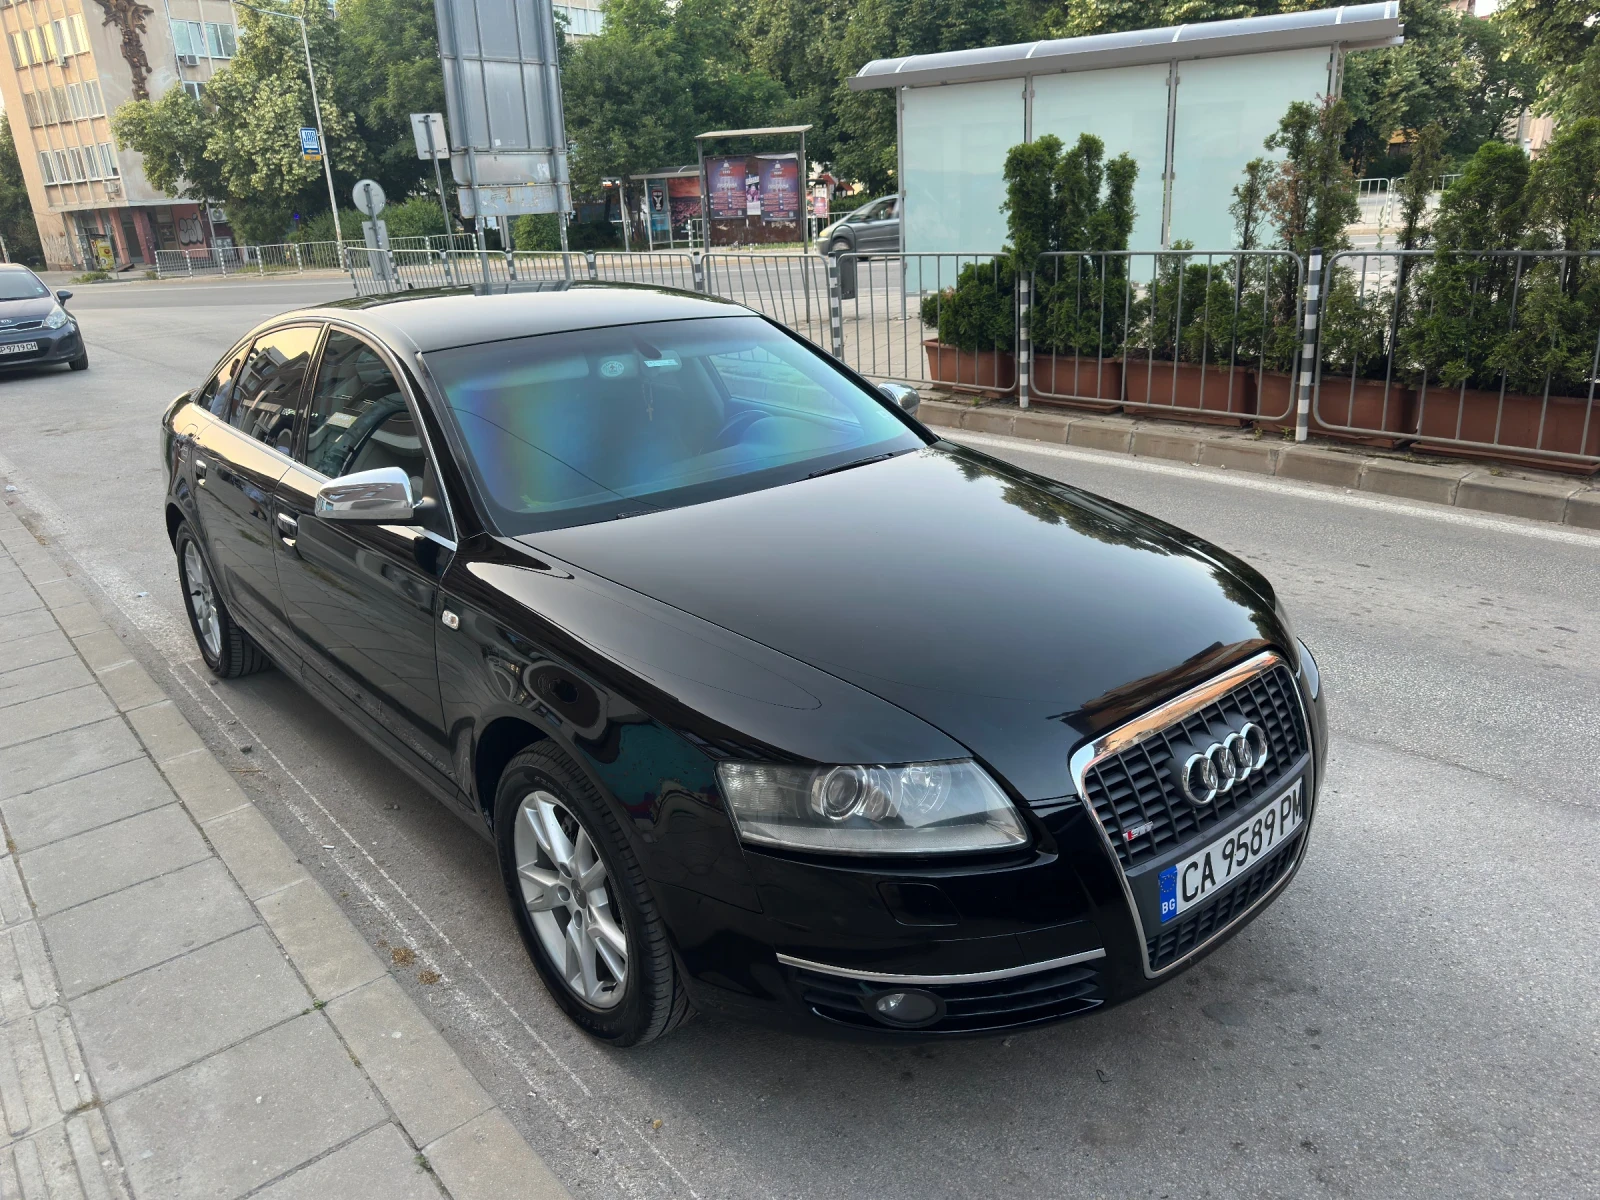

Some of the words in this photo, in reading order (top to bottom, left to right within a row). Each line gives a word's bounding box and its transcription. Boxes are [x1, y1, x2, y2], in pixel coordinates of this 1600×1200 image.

[6, 344, 25, 352] 9719
[26, 342, 37, 350] CH
[1182, 852, 1216, 903] CA
[1222, 808, 1276, 877] 9589
[1279, 785, 1302, 836] PM
[1162, 899, 1175, 915] BG
